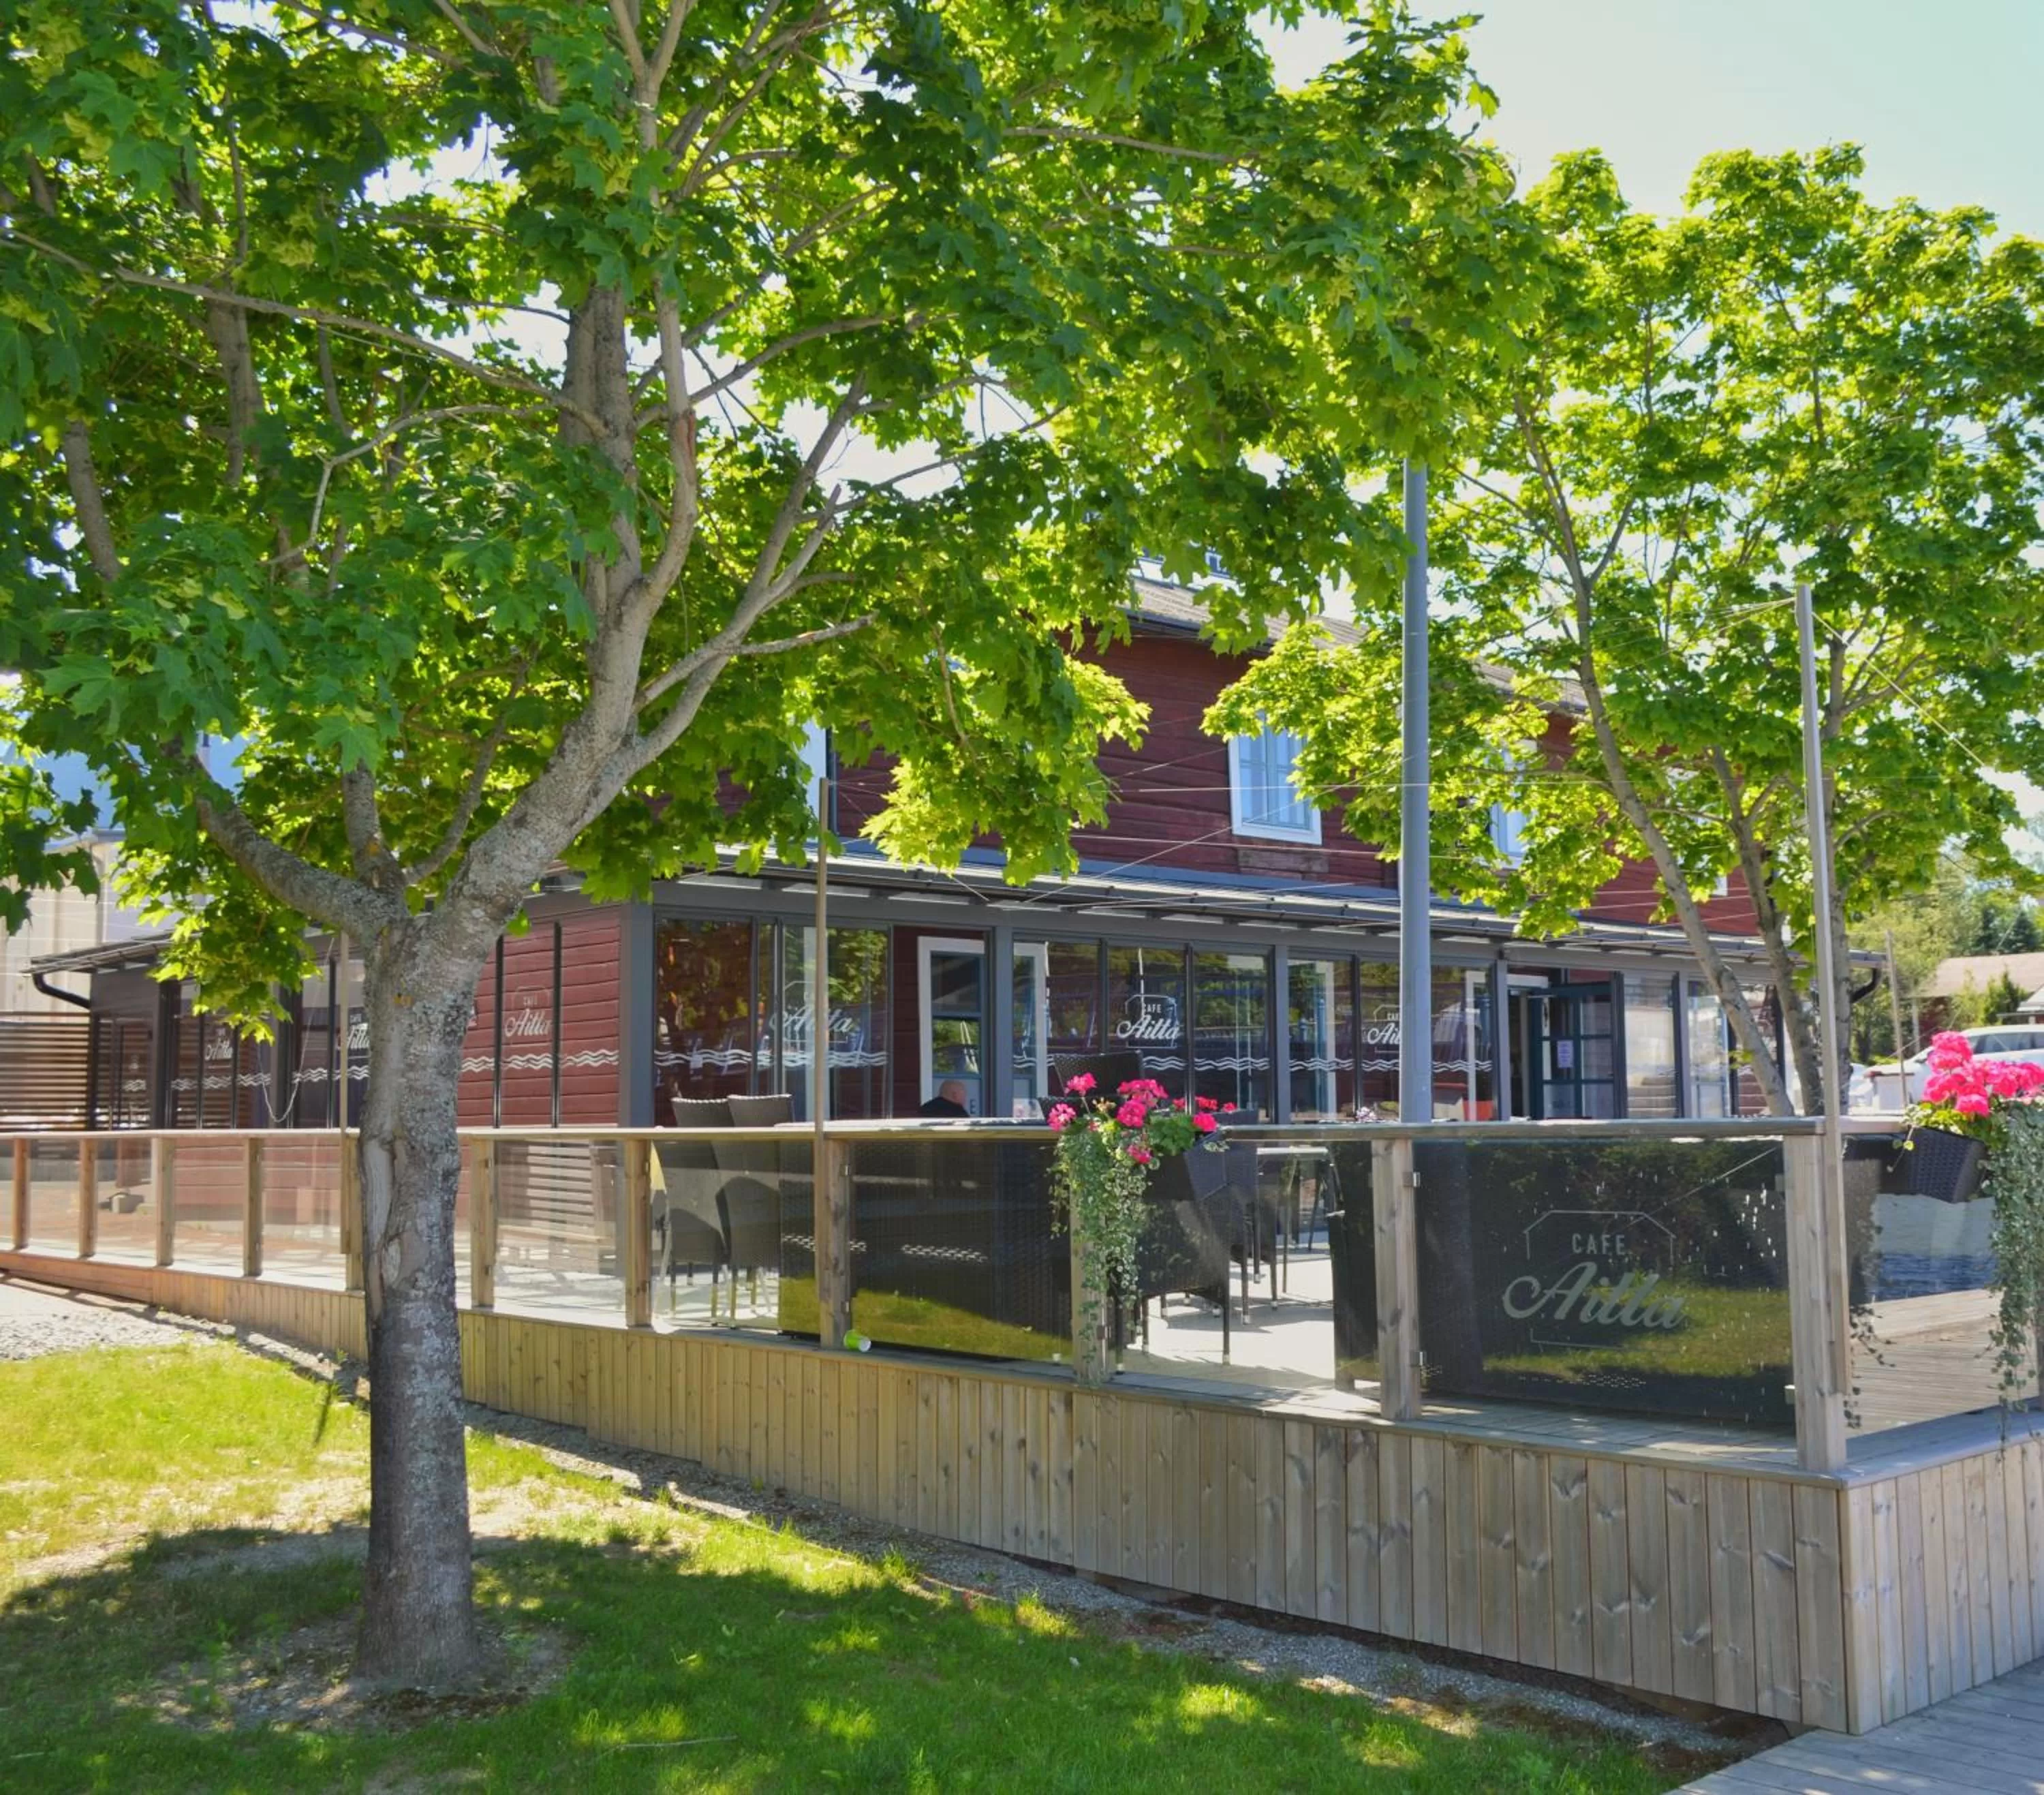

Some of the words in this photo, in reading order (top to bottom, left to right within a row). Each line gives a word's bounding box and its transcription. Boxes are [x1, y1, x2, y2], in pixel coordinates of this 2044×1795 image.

[1116, 1014, 1179, 1039] Aitta
[1571, 1233, 1626, 1255] CAFE
[1502, 1261, 1686, 1330] Aitta
